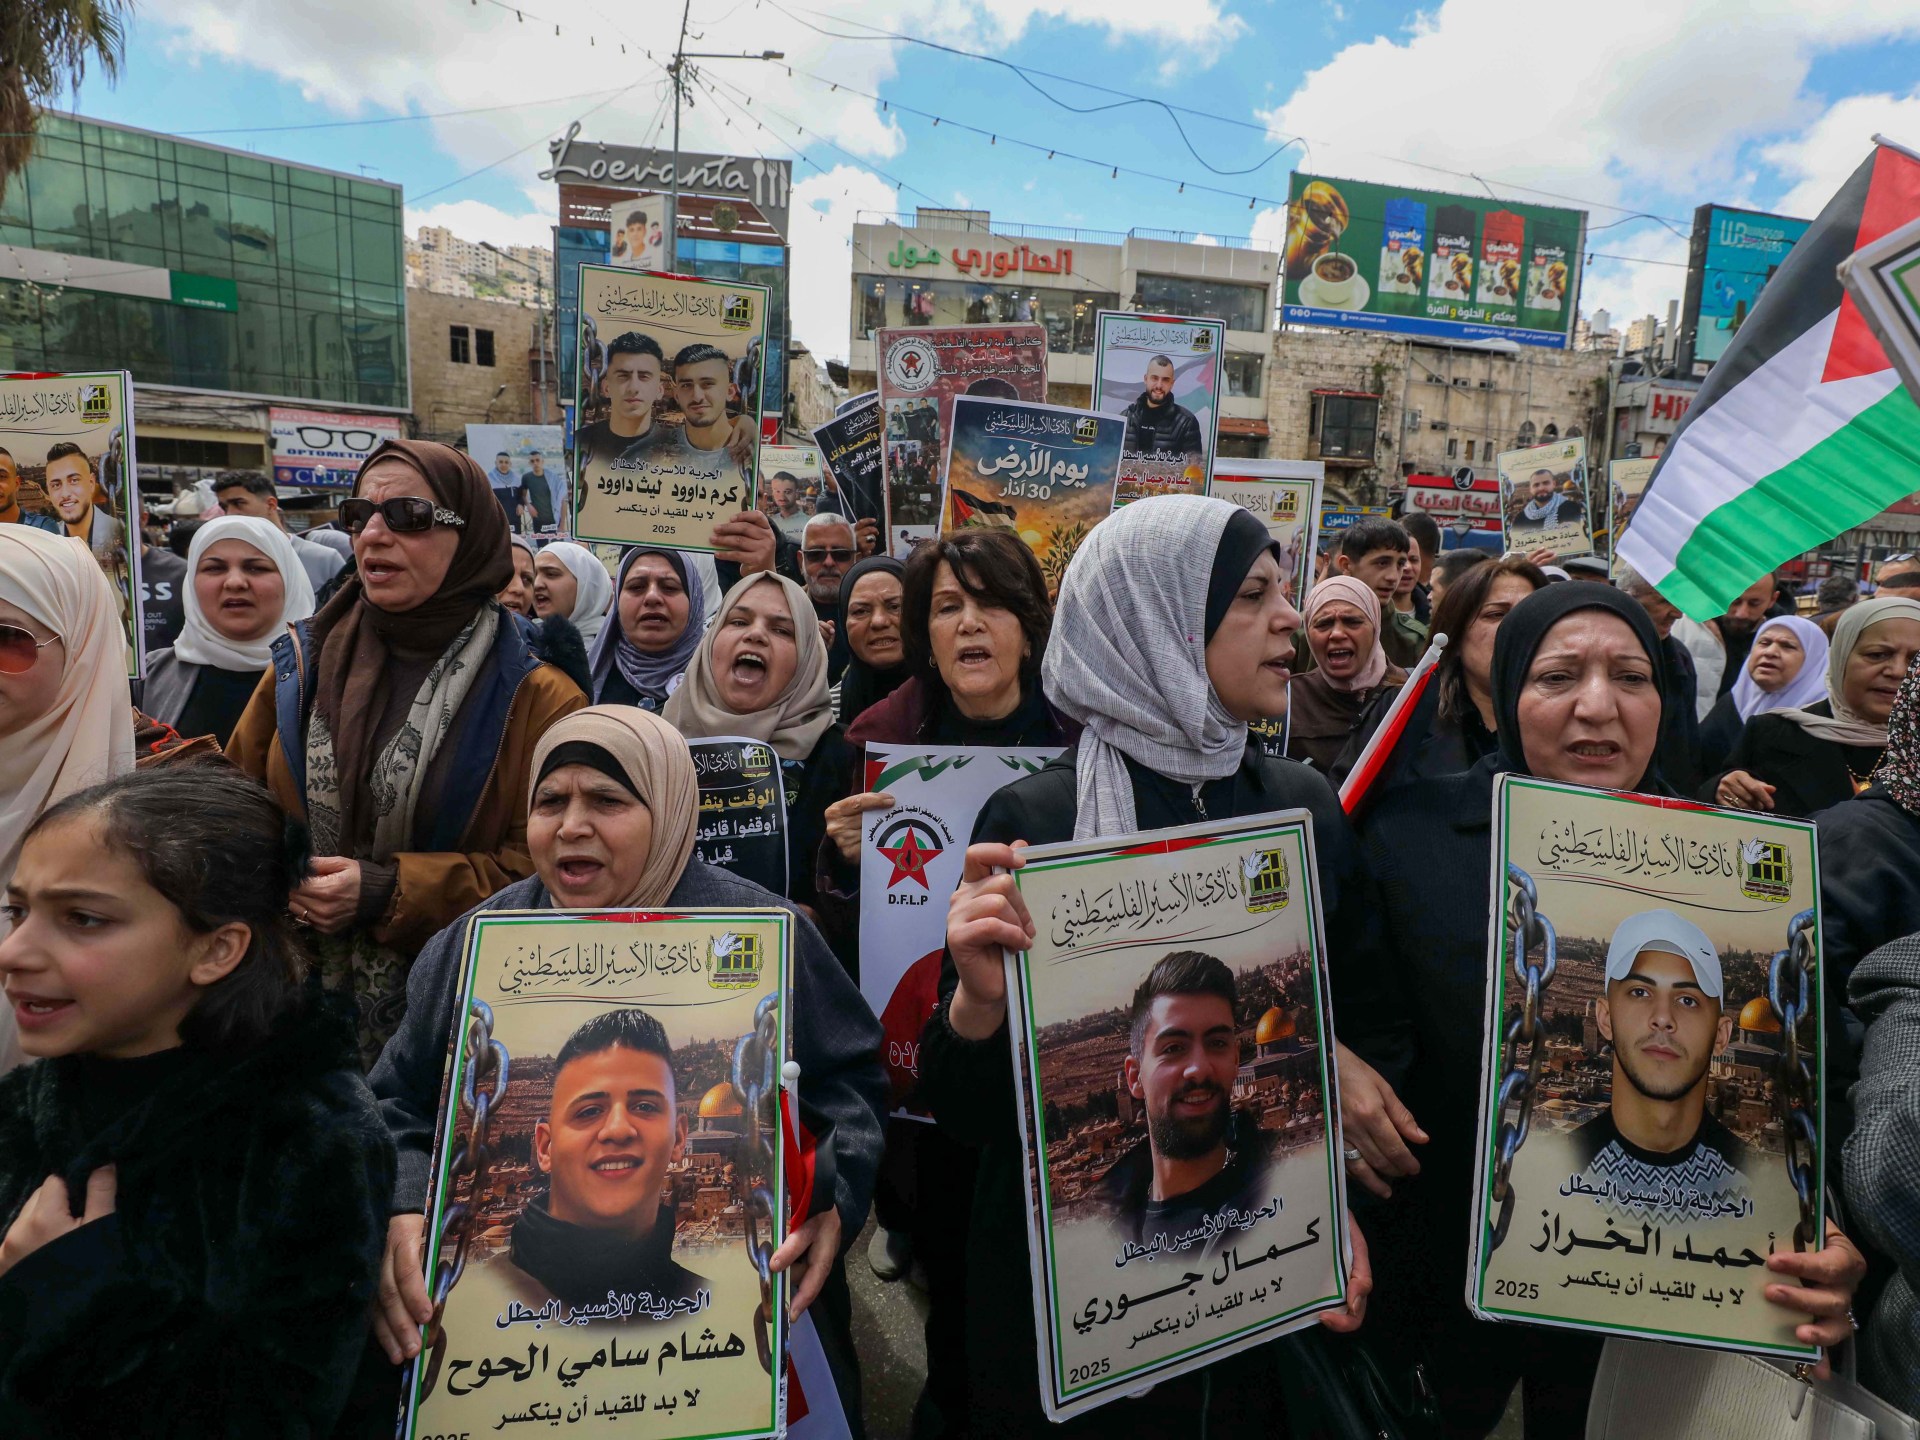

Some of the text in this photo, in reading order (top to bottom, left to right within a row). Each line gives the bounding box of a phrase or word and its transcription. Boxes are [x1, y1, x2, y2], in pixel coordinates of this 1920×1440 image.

[537, 120, 750, 191] Loevanta
[889, 240, 1072, 277] الصانوري مول
[597, 285, 659, 317] الفلسطيني
[688, 293, 717, 317] نادي
[1171, 330, 1190, 345] نادي
[49, 390, 76, 415] نادي
[984, 410, 1031, 434] الفلسطيني
[1051, 416, 1072, 436] نادي
[610, 456, 649, 472] الأبطال
[865, 444, 881, 460] عدام
[977, 442, 1052, 479] الأرض
[688, 465, 724, 481] الحرية
[1050, 459, 1089, 489] يوم
[1138, 470, 1166, 488] جمال
[597, 474, 738, 506] كرم داوود ليث داوود
[1027, 483, 1052, 500] 30
[1248, 491, 1269, 513] نادي
[615, 503, 715, 521] لا بد للقيد أن ينكسر
[652, 524, 676, 535] 2025
[709, 749, 738, 773] نادي
[728, 787, 775, 810] الوقت
[733, 813, 776, 838] أوقفوا
[708, 845, 733, 865] قبل
[1537, 820, 1638, 875] الفلسطيني
[1686, 840, 1733, 878] نادي
[888, 893, 929, 906] D.F.L.P
[1194, 862, 1238, 907] نادي
[1050, 878, 1152, 949] الفلسطيني
[498, 942, 606, 995] الفلسطيني
[655, 939, 702, 976] نادي
[1558, 1173, 1754, 1220] الحرية للأسير البطل
[1114, 1196, 1284, 1269] الحرية للأسير البطل
[1530, 1208, 1778, 1268] أحمد الخراز
[1073, 1217, 1321, 1335] كمال جوري
[1494, 1279, 1540, 1300] 2025
[1558, 1270, 1745, 1308] لا بد للقيد أن ينكسر
[495, 1288, 711, 1330] الحرية للأسير البطل
[1126, 1276, 1284, 1349] لا بد للقيد أن ينكسر
[447, 1327, 746, 1395] هشام سامي الحوح
[1069, 1356, 1112, 1385] 2025
[493, 1387, 701, 1430] لا بد للقيد أن ينكسر
